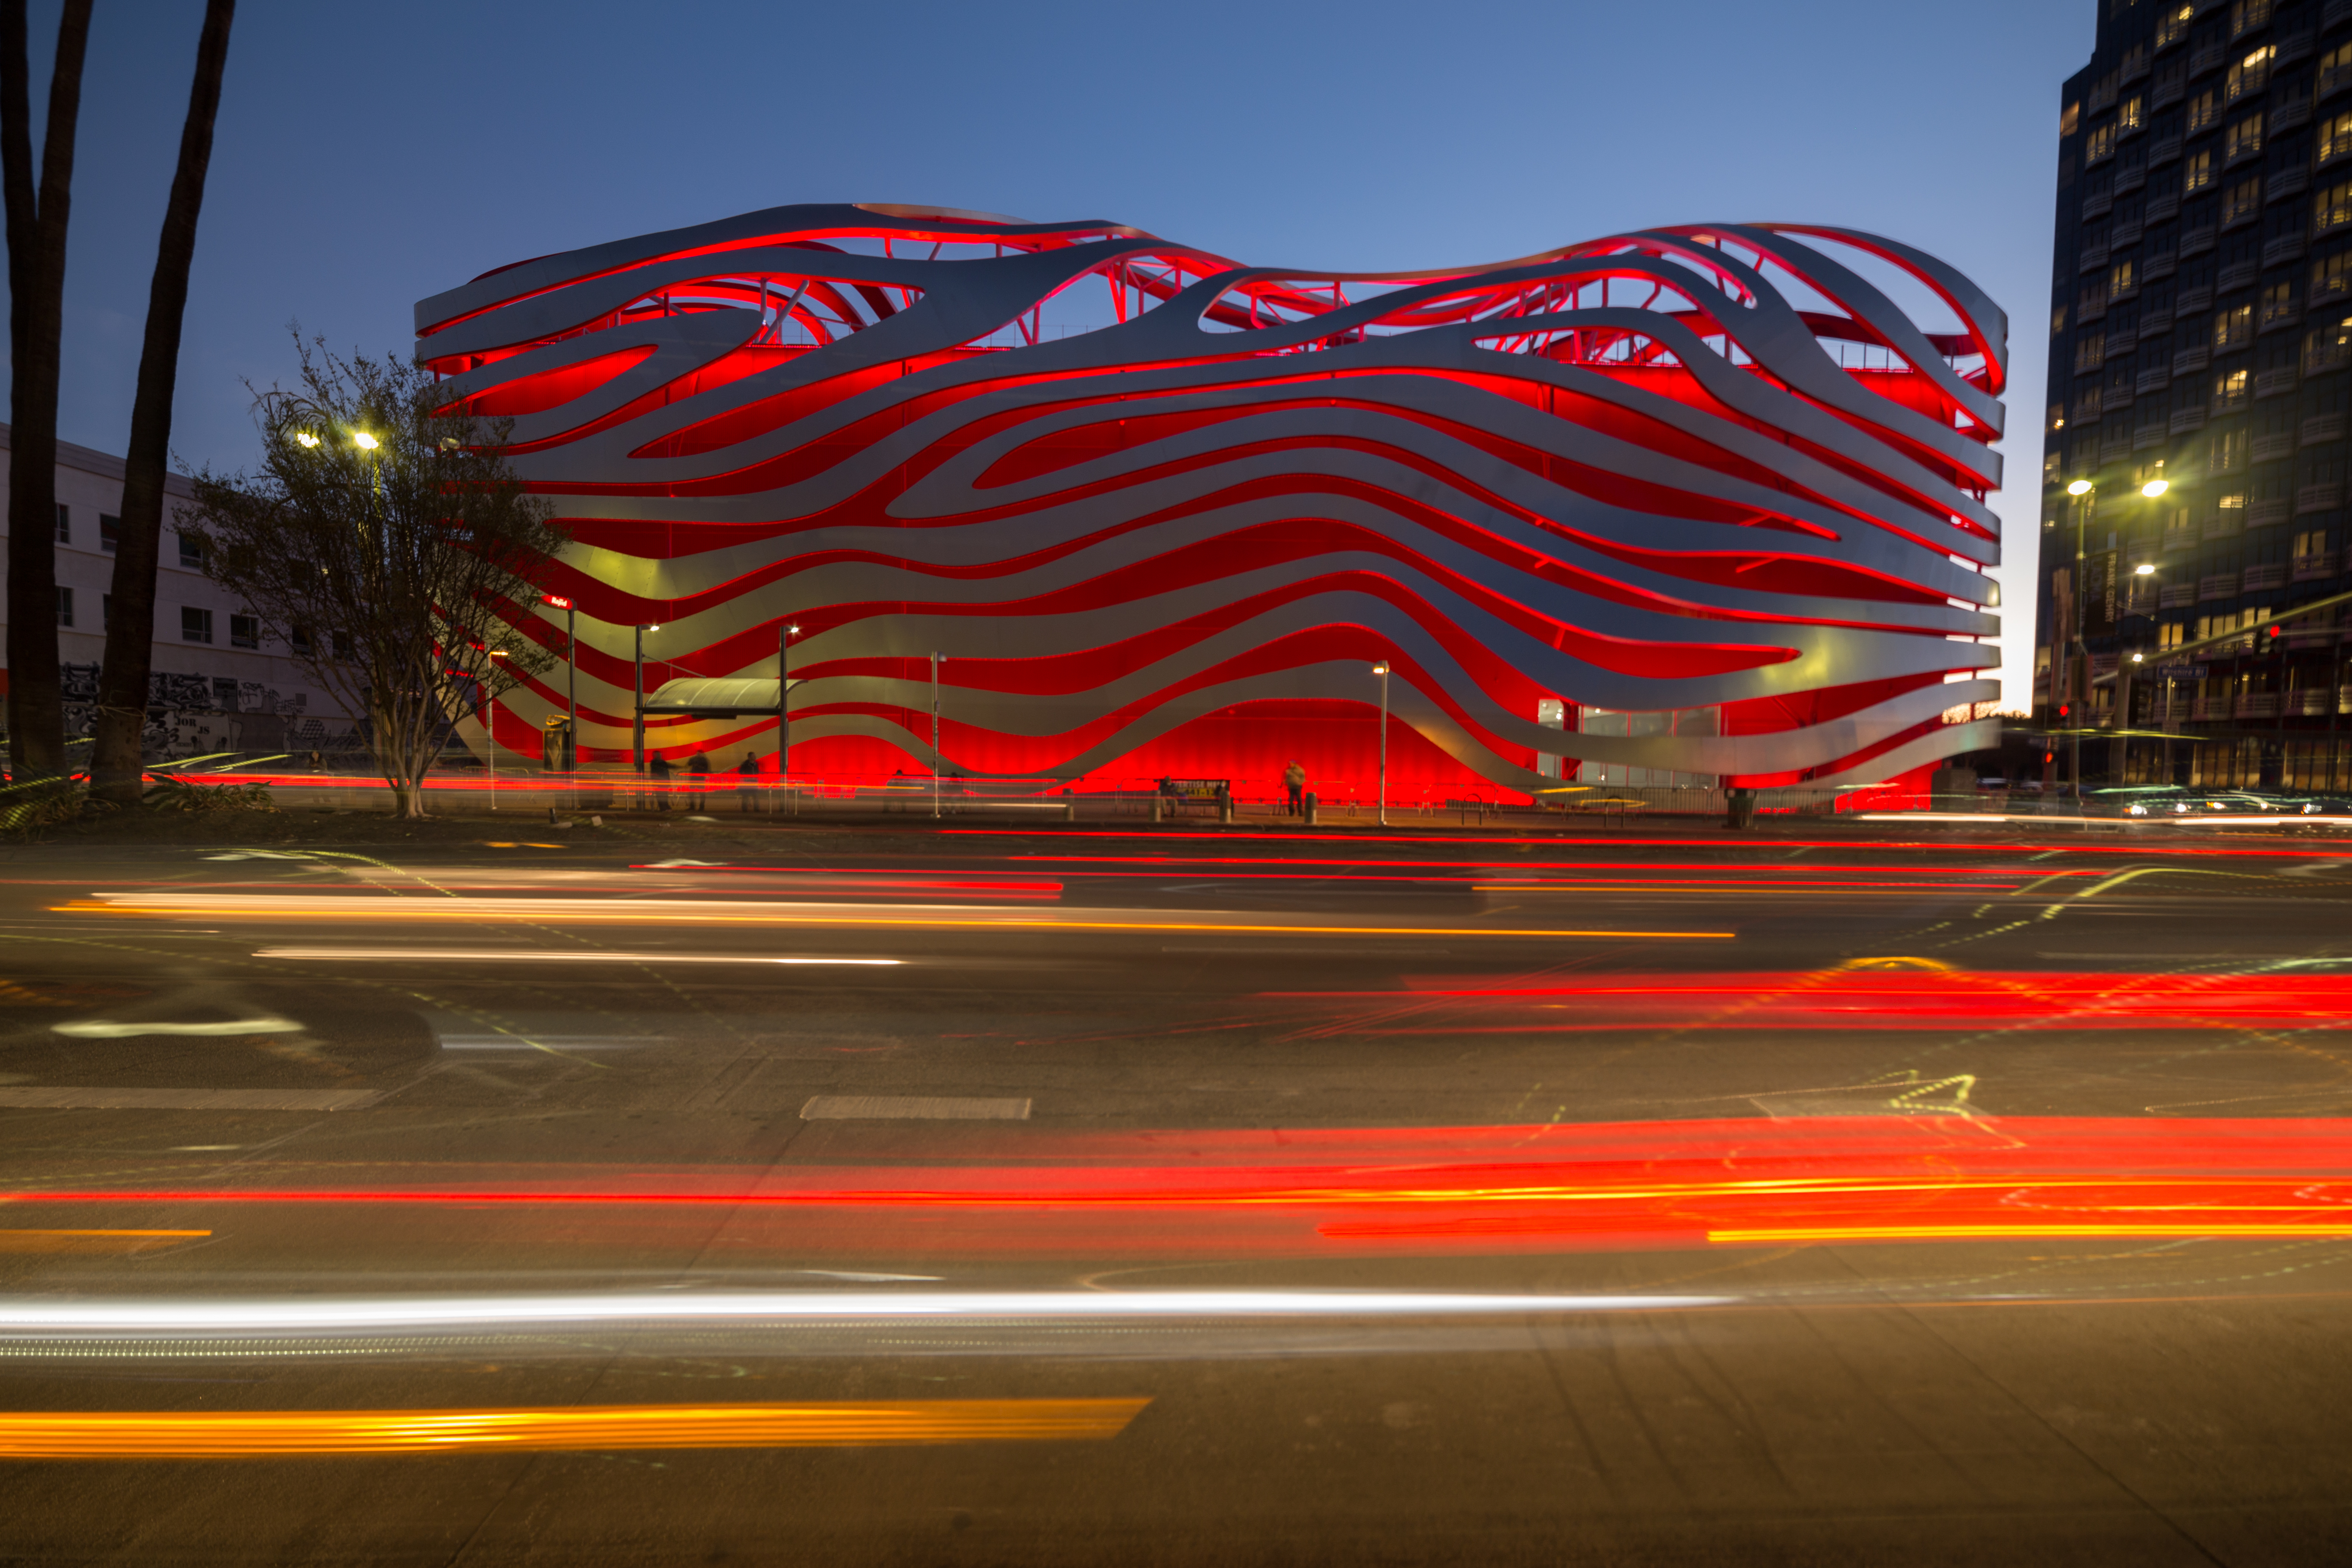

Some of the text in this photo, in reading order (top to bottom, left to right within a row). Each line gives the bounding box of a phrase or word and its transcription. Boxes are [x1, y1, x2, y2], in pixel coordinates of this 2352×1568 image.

[2105, 553, 2116, 623] FRANK GEHRY
[551, 596, 567, 607] Rapid
[2162, 668, 2193, 676] Wilshire
[175, 718, 196, 727] JOR
[197, 726, 210, 734] JS
